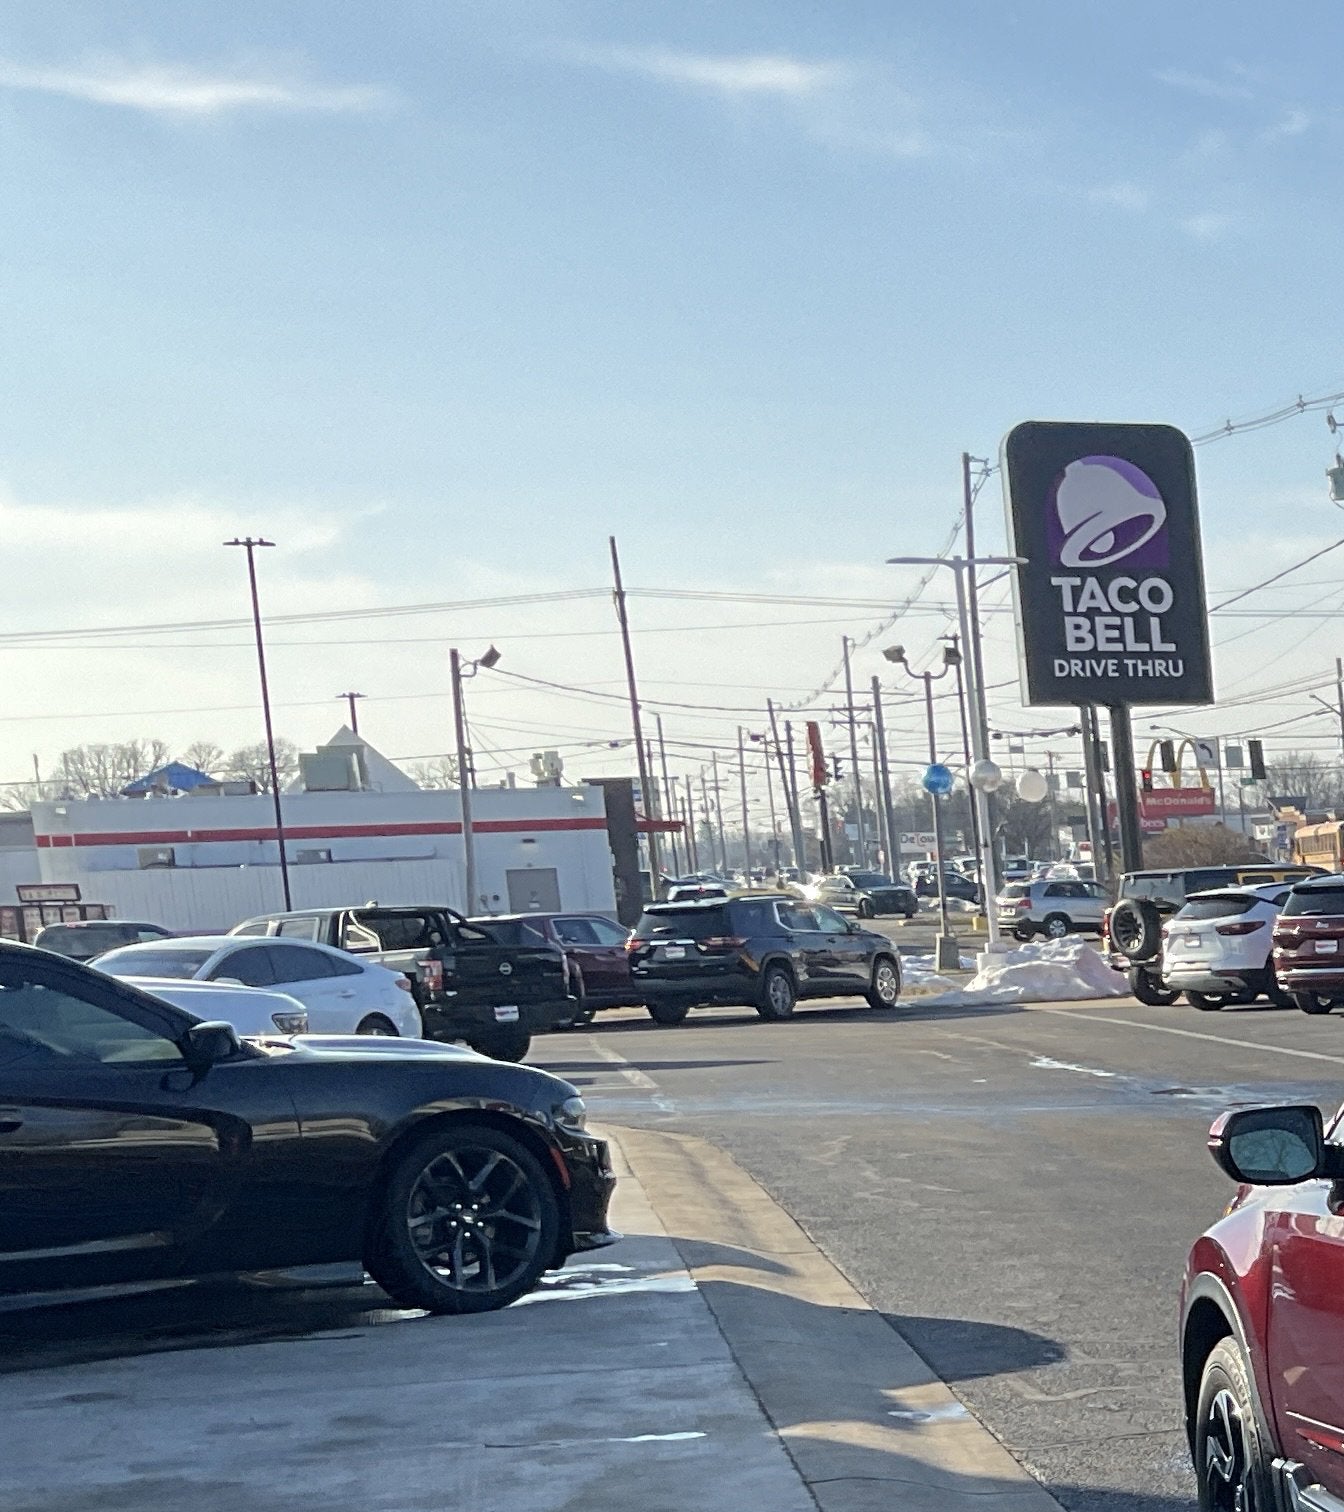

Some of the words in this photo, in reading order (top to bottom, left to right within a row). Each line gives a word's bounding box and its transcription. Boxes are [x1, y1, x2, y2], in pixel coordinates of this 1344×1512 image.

[1050, 576, 1174, 614] TACO
[1064, 615, 1177, 652] BELL
[1053, 658, 1120, 677] DRIVE
[1123, 659, 1184, 677] THRU
[1145, 795, 1213, 806] McDonald's
